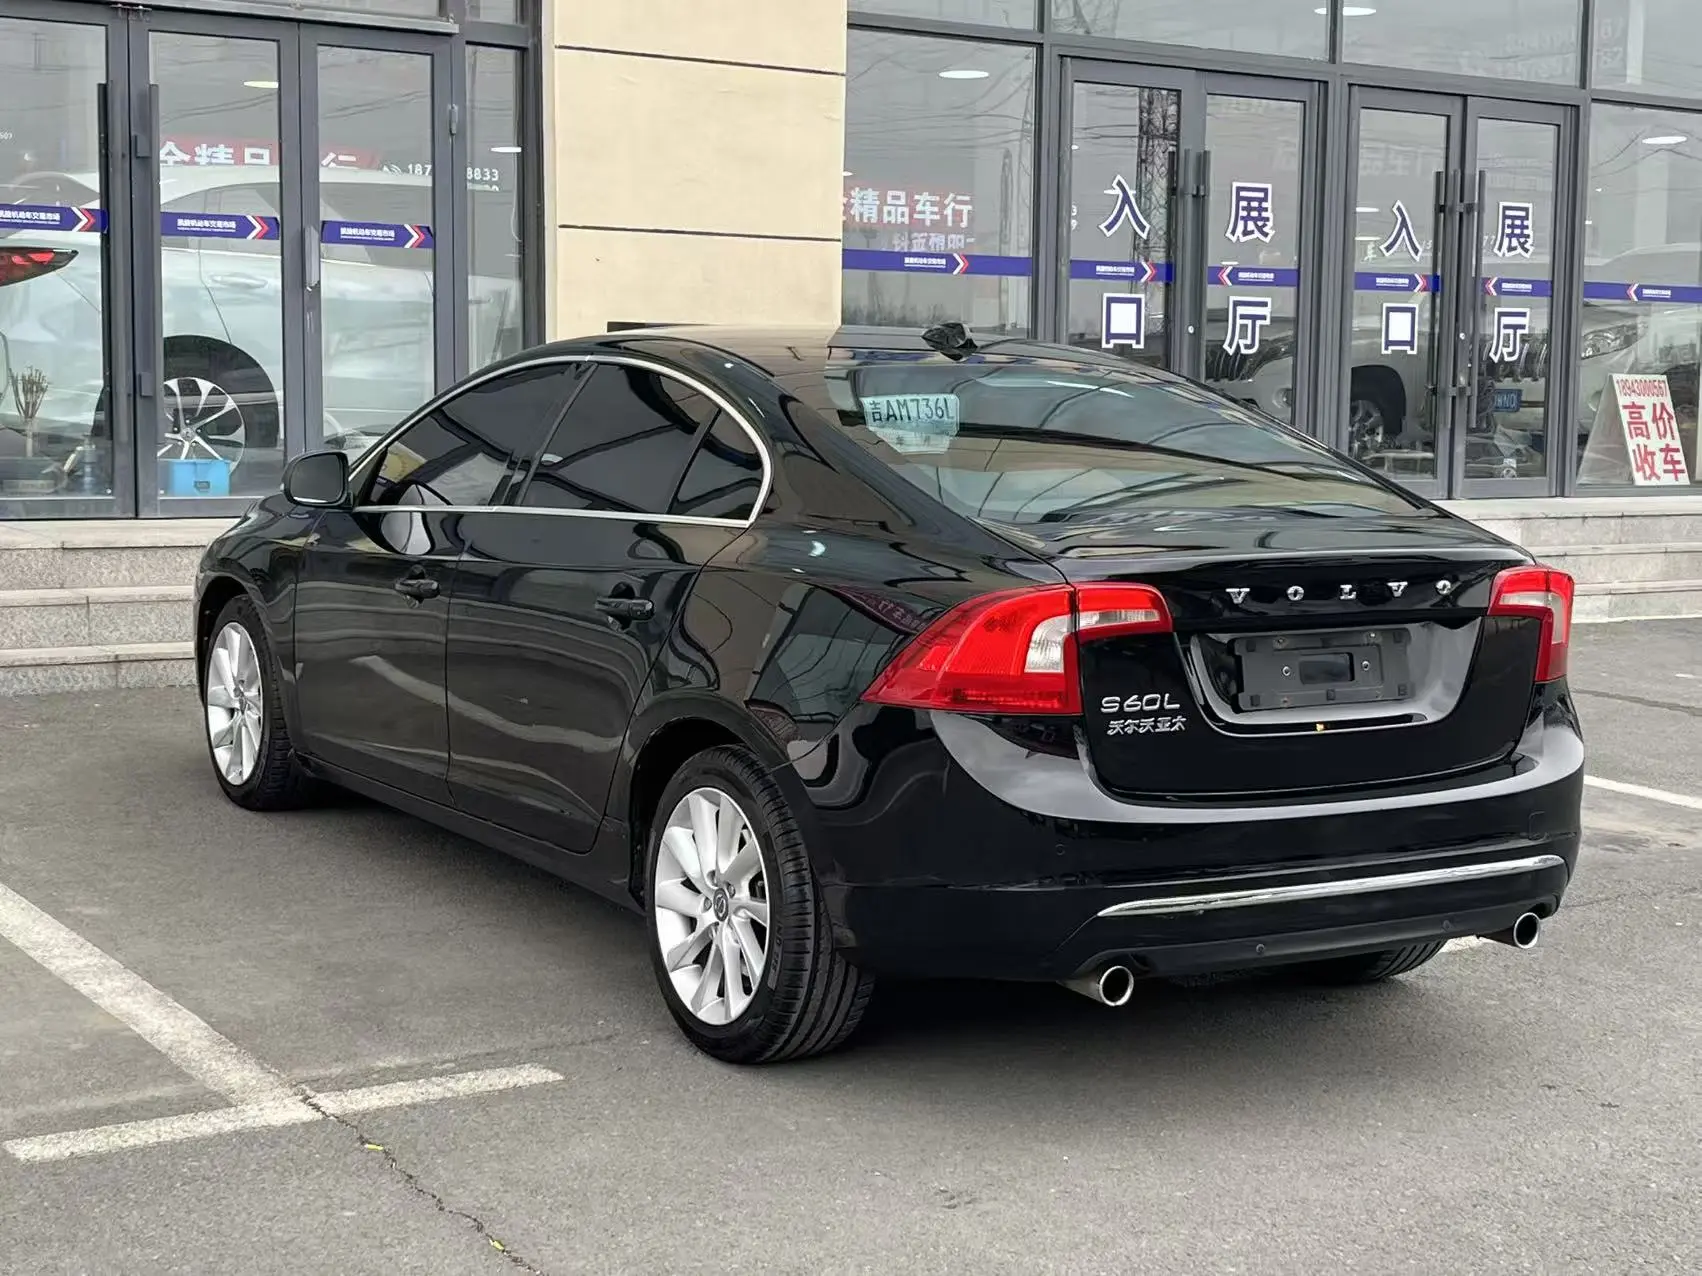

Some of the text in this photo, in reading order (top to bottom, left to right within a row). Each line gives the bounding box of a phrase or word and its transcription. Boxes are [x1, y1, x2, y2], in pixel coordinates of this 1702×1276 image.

[1622, 401, 1676, 440] 高价
[1632, 443, 1686, 481] 收车
[1225, 579, 1452, 604] VOLVO
[1100, 693, 1180, 713] S60L
[1106, 715, 1187, 736] 沃尔沃亚太
